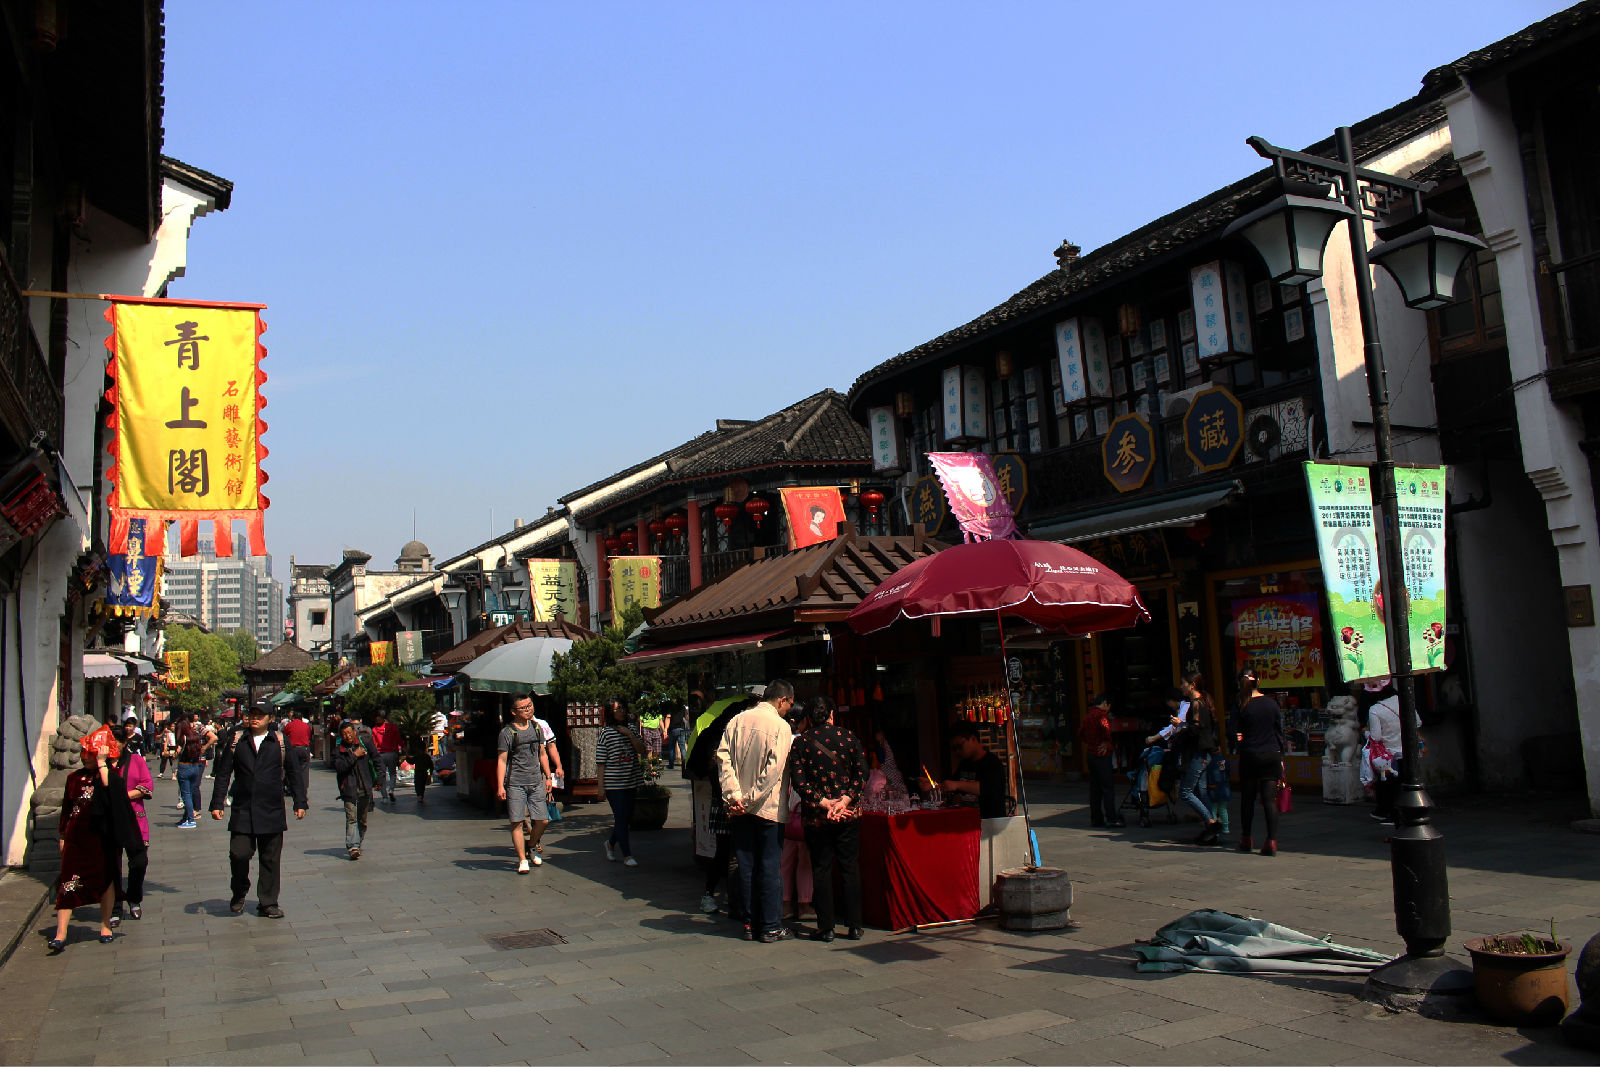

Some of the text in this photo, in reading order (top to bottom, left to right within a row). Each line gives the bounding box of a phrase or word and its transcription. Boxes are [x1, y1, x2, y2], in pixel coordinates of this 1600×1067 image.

[164, 320, 209, 498] 青上閣
[222, 380, 243, 498] 石雕藝術館
[1199, 408, 1229, 452] 藏
[919, 483, 938, 523] 燕
